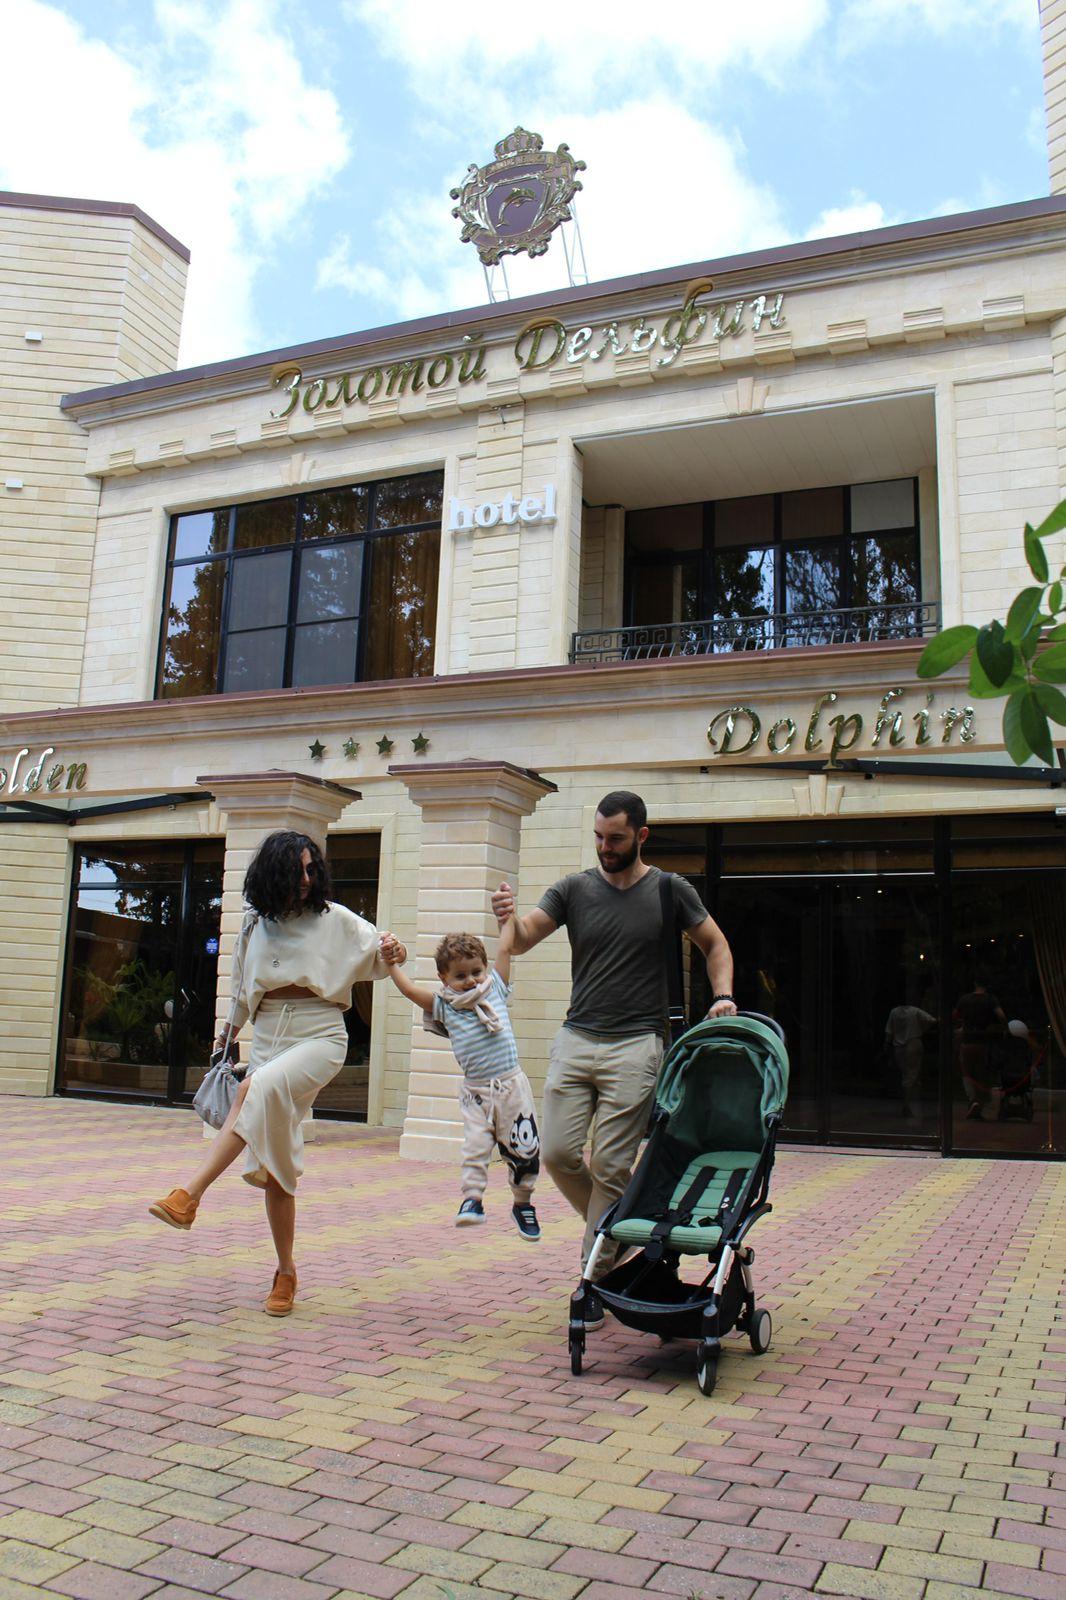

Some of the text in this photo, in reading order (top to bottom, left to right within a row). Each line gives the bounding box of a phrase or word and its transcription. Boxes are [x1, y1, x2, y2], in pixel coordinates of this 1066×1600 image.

[270, 277, 786, 418] Золотой Дельфин
[448, 484, 557, 532] hotel
[707, 687, 978, 769] Dolphin
